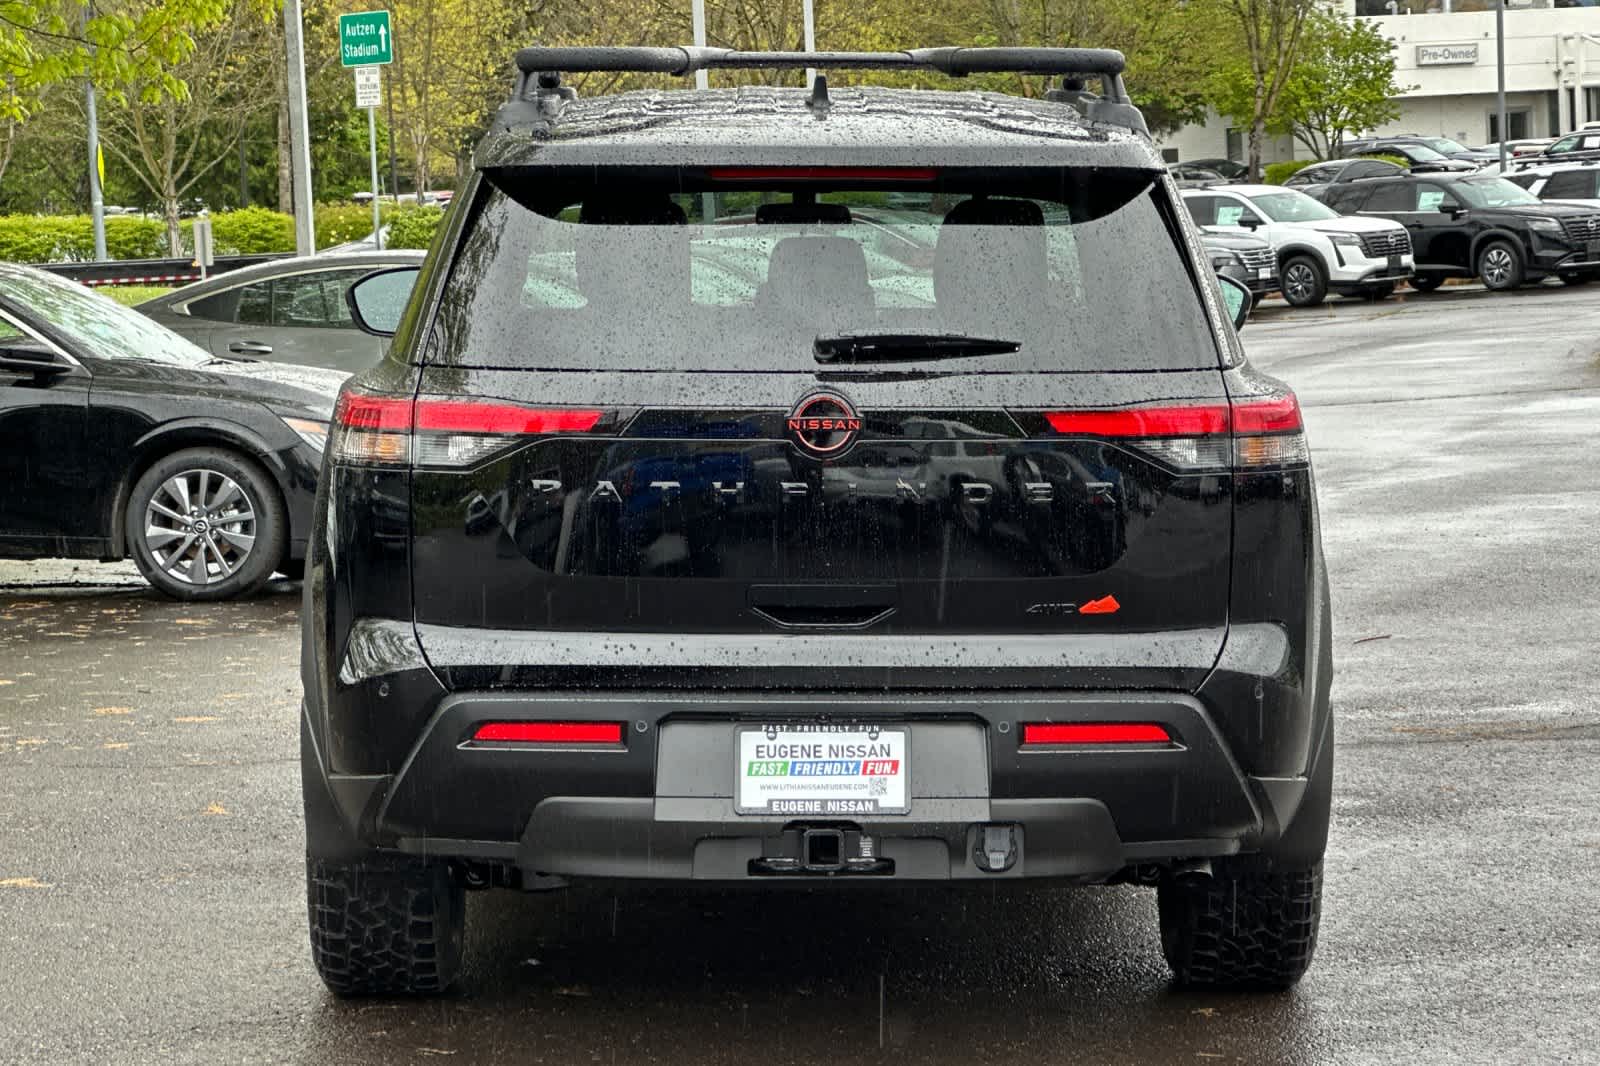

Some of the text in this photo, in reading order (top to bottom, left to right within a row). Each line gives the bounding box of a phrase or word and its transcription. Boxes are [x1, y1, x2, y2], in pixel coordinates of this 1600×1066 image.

[345, 22, 376, 37] Autzen
[344, 42, 379, 58] Stadium
[1421, 47, 1477, 60] Pre-Owned
[788, 419, 861, 430] NISSAN
[531, 478, 1116, 504] PATHFINDER
[755, 743, 891, 759] EUGENE NISSAN
[751, 762, 896, 776] FAST. FRIENDLY. FUN.
[772, 800, 874, 812] EUGENE NISSAN
